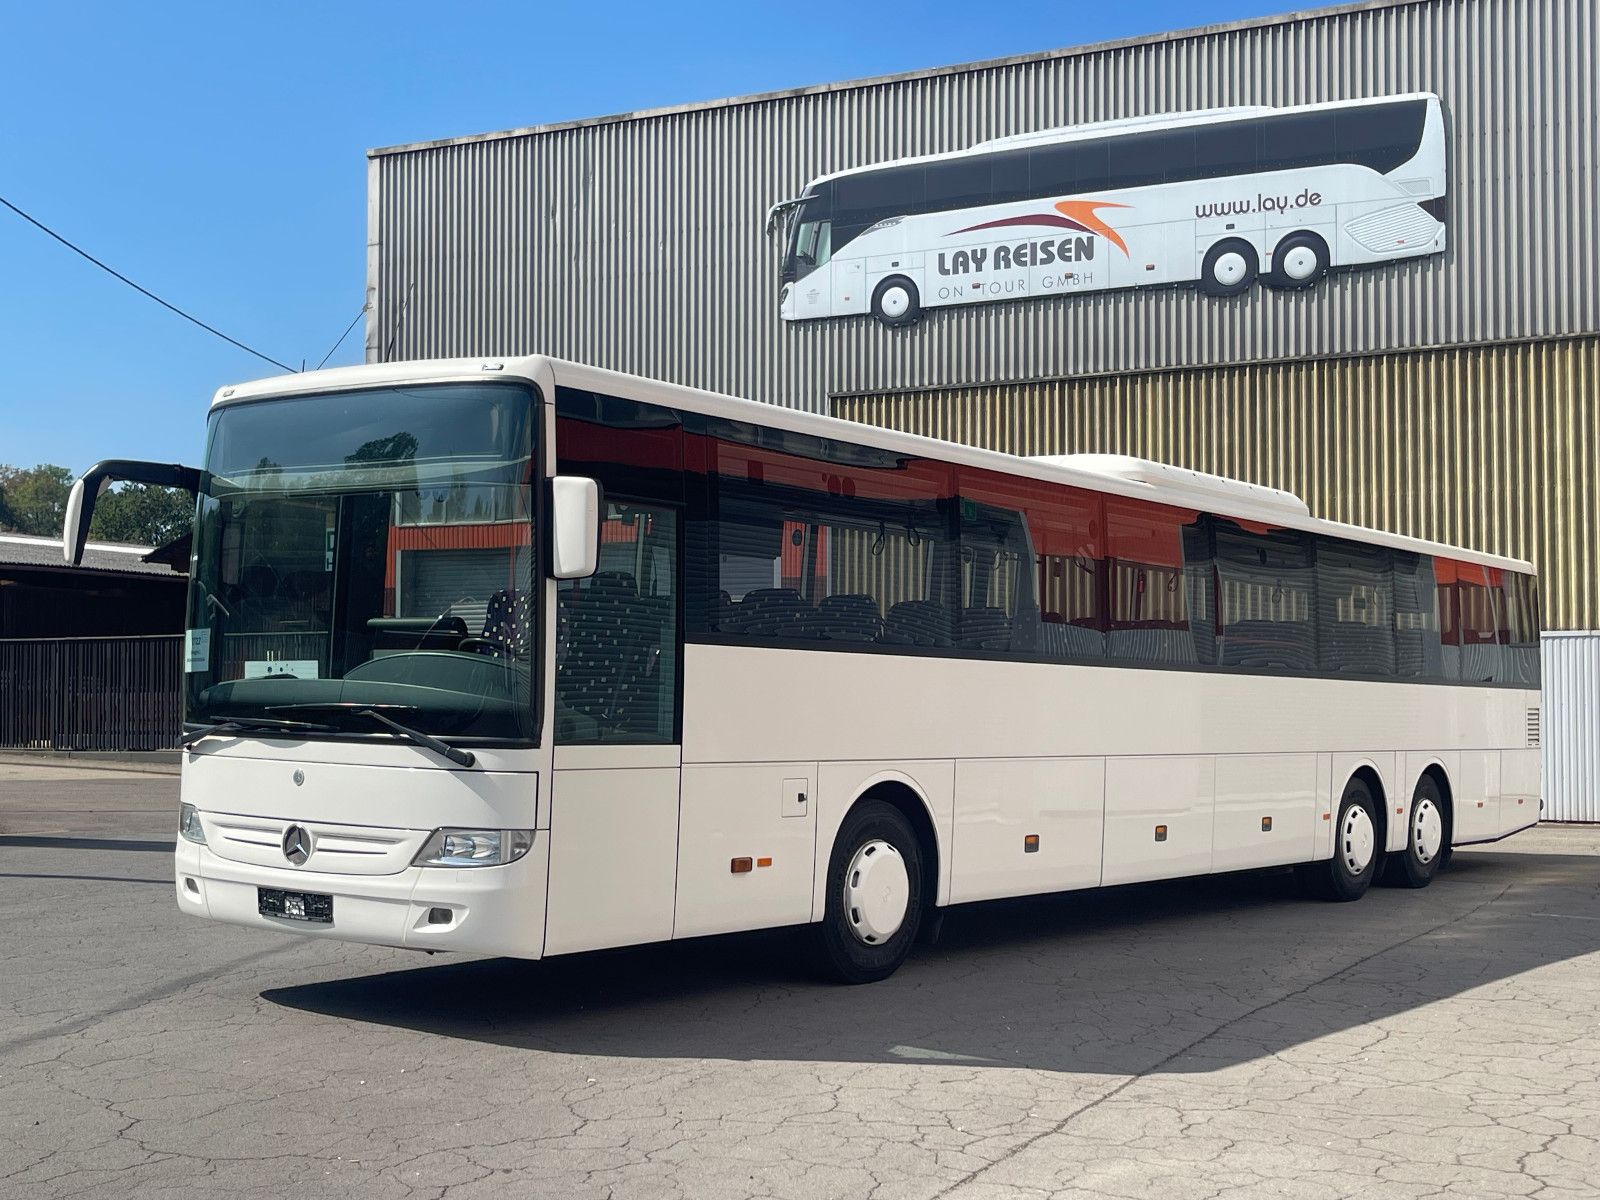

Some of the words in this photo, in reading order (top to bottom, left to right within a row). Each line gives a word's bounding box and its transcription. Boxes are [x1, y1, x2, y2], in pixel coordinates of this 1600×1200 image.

[1195, 188, 1322, 218] www.lay.de
[938, 248, 988, 276] LAY
[994, 236, 1095, 270] REISEN
[938, 286, 963, 300] ON
[980, 279, 1026, 295] TOUR
